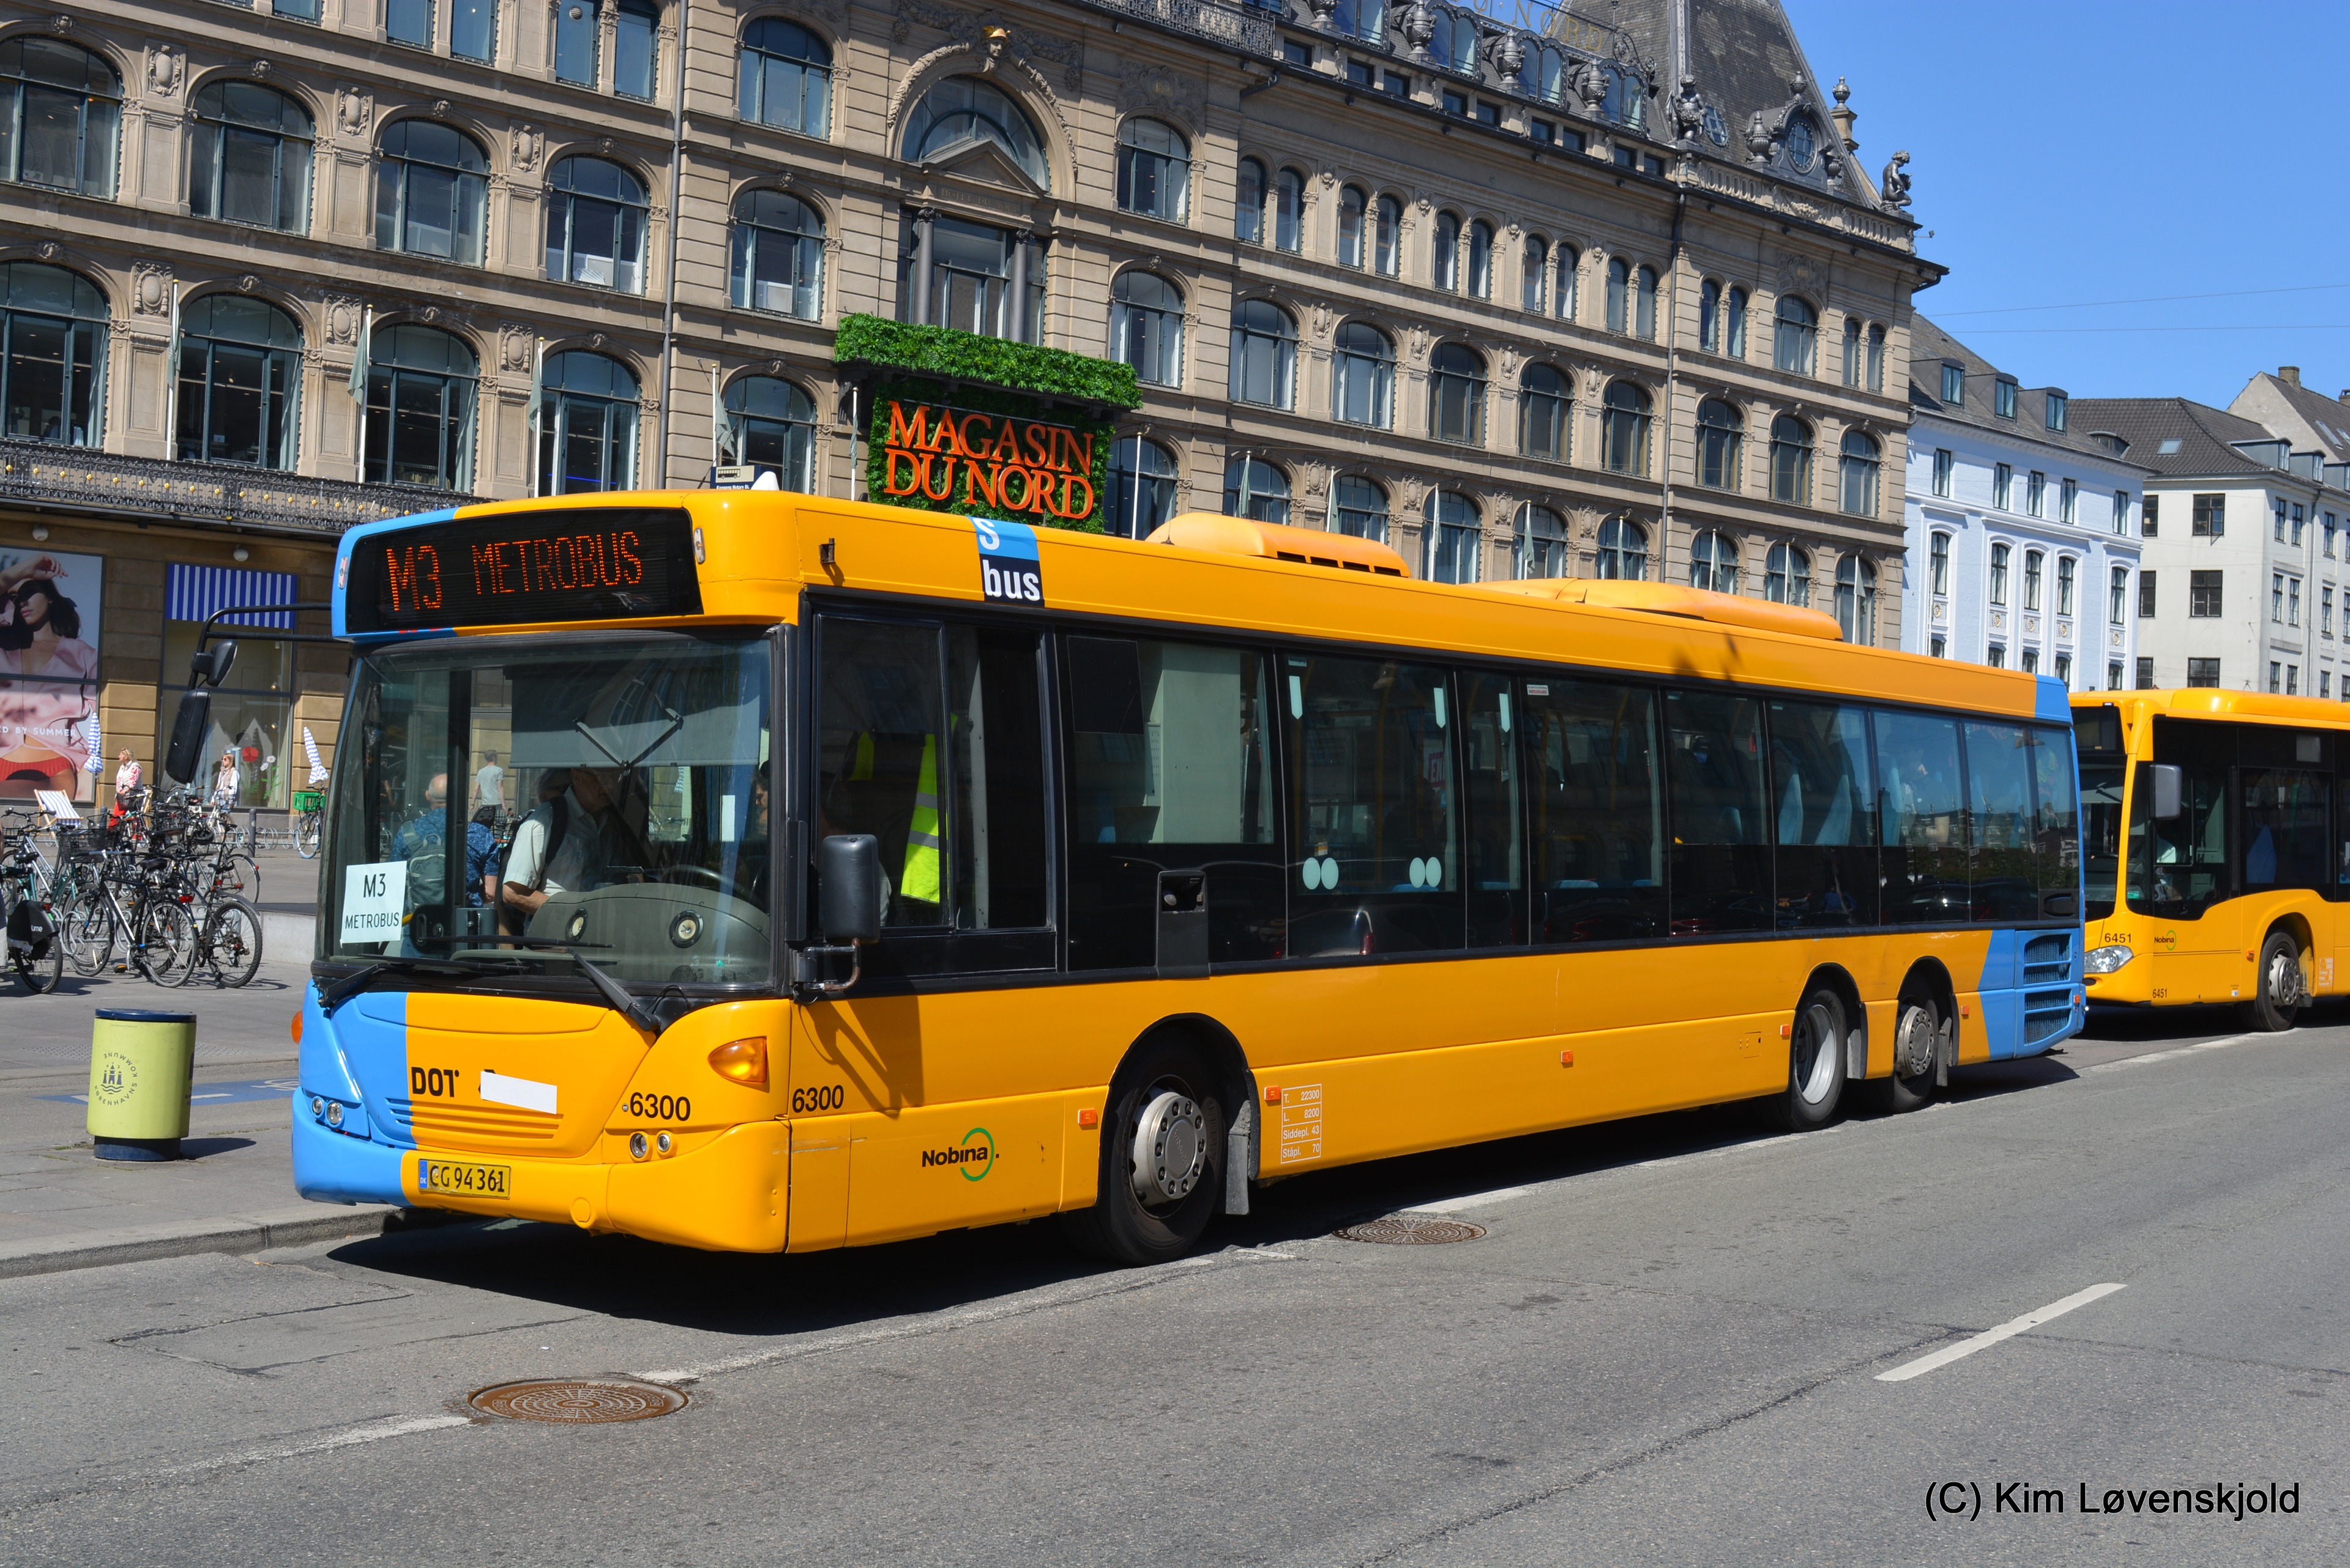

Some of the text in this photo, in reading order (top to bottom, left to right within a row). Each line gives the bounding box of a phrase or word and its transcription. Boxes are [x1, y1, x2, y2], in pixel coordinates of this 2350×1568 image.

[886, 400, 1094, 476] MAGASIN
[884, 447, 1094, 519] DU NORD
[972, 518, 1000, 550] S
[386, 531, 642, 611] M3 METROBUS
[982, 559, 1040, 601] bus
[33, 727, 76, 737] SUMMER
[363, 873, 386, 898] M3
[345, 912, 400, 930] METROBUS
[2104, 933, 2132, 943] 6451
[2152, 988, 2168, 998] 6451
[103, 1051, 138, 1078] KOMMUNE
[94, 1082, 138, 1106] KØBENHAVNS
[792, 1085, 844, 1113] 6300
[1284, 1089, 1320, 1103] T. 22300
[630, 1092, 691, 1121] 6300
[1283, 1107, 1319, 1122] L. 8200
[1283, 1125, 1319, 1140] Siddepl. 43
[1282, 1143, 1320, 1159] Ståpl. 70
